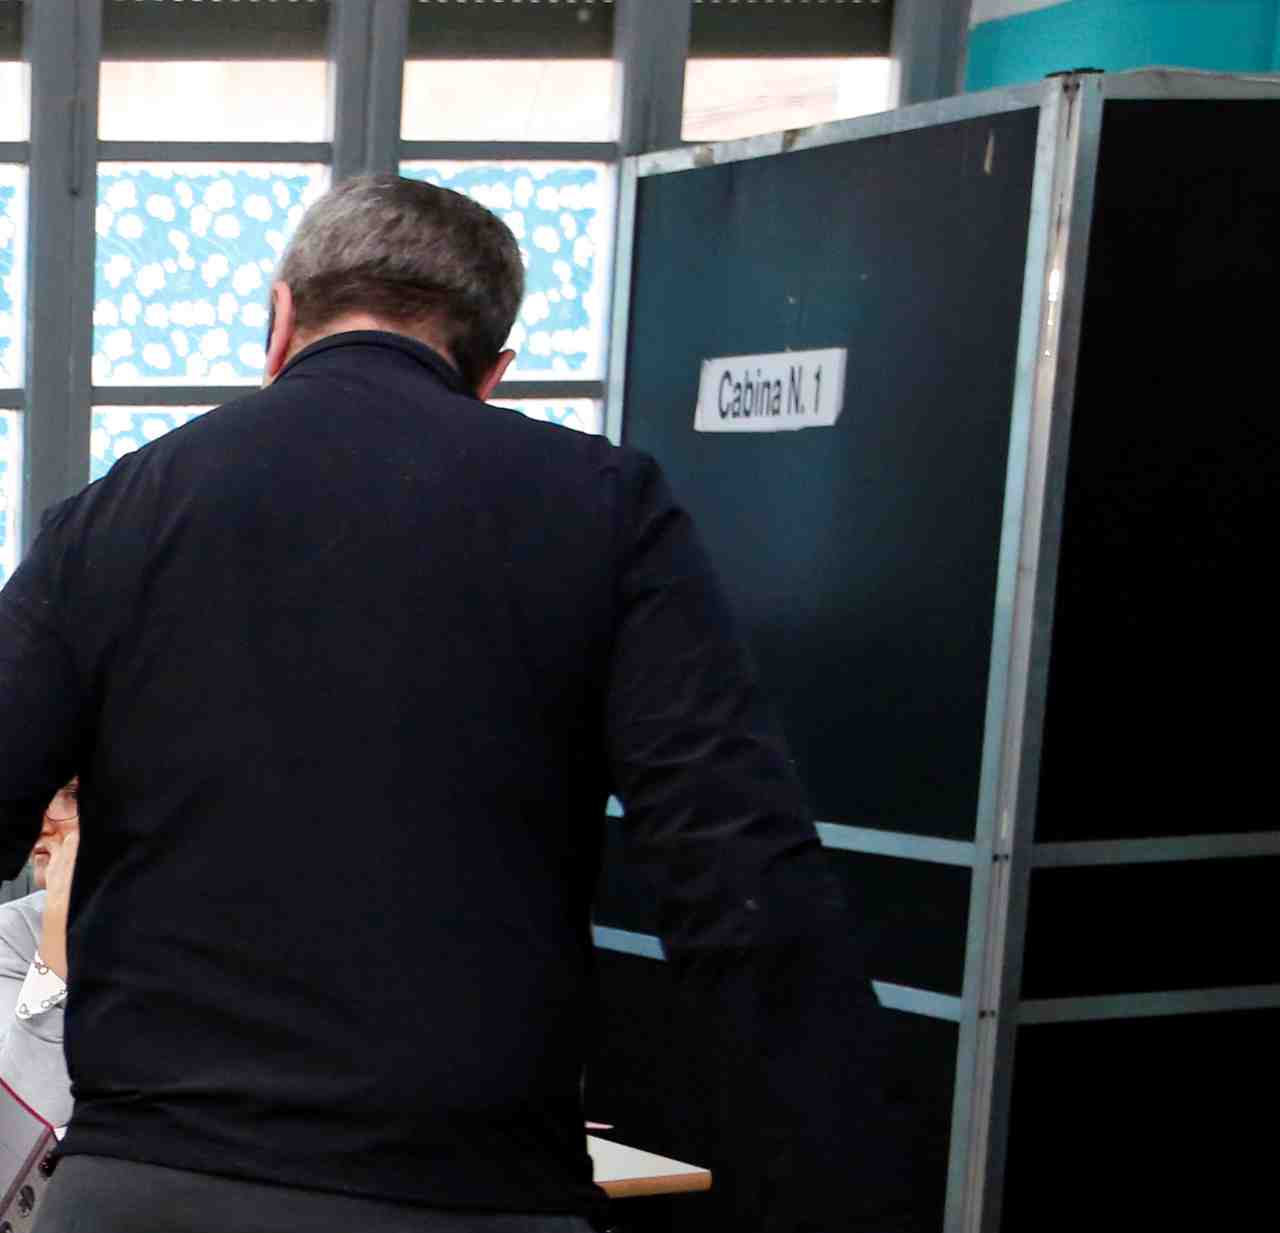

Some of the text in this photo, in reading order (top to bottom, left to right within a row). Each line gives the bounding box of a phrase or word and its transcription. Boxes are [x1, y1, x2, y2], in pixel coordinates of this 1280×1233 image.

[718, 363, 822, 419] Cabina N. 1
